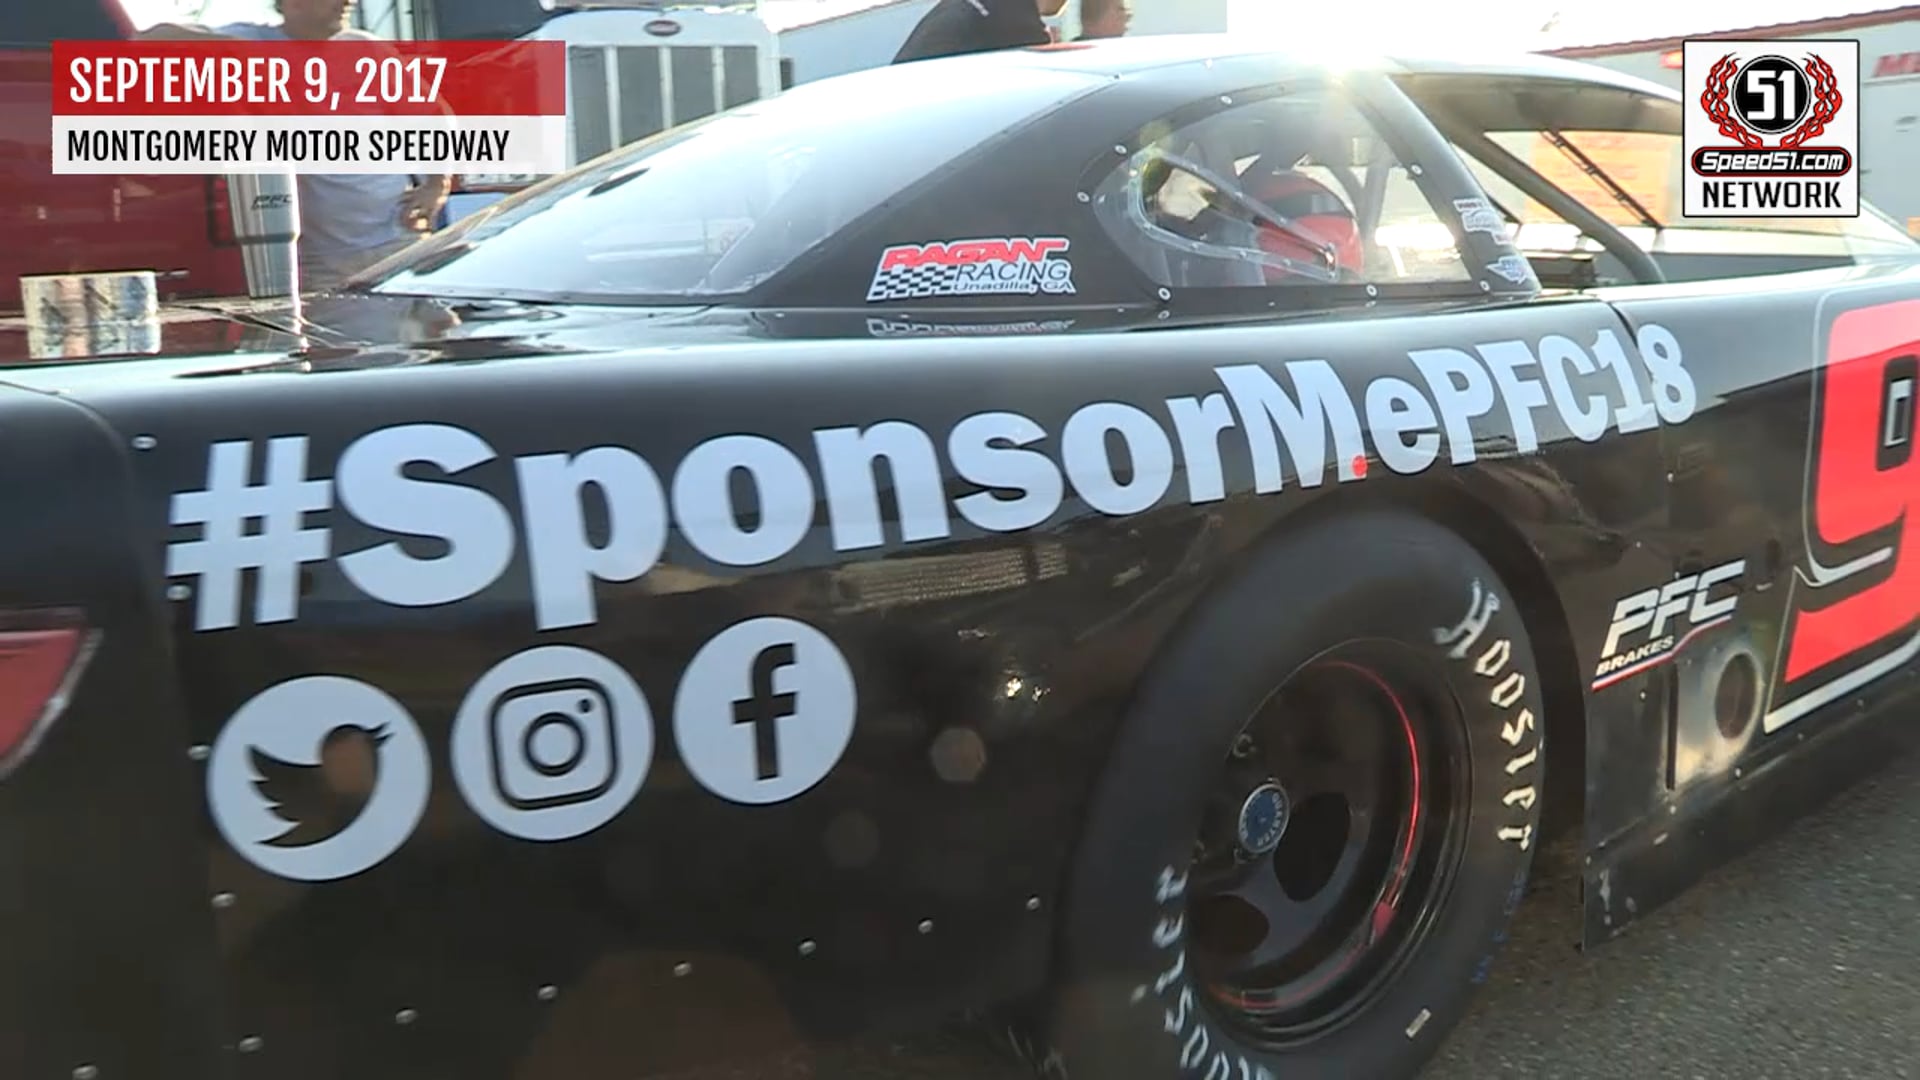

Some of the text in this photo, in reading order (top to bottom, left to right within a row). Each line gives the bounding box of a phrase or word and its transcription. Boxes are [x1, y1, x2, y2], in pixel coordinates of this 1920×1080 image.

[881, 240, 1067, 270] RAGAN
[955, 262, 1068, 282] RACING
[1045, 281, 1073, 291] GA
[167, 323, 1698, 632] #SponsorMePFC18
[1601, 559, 1746, 659] PFC
[1595, 635, 1674, 666] BRAKES
